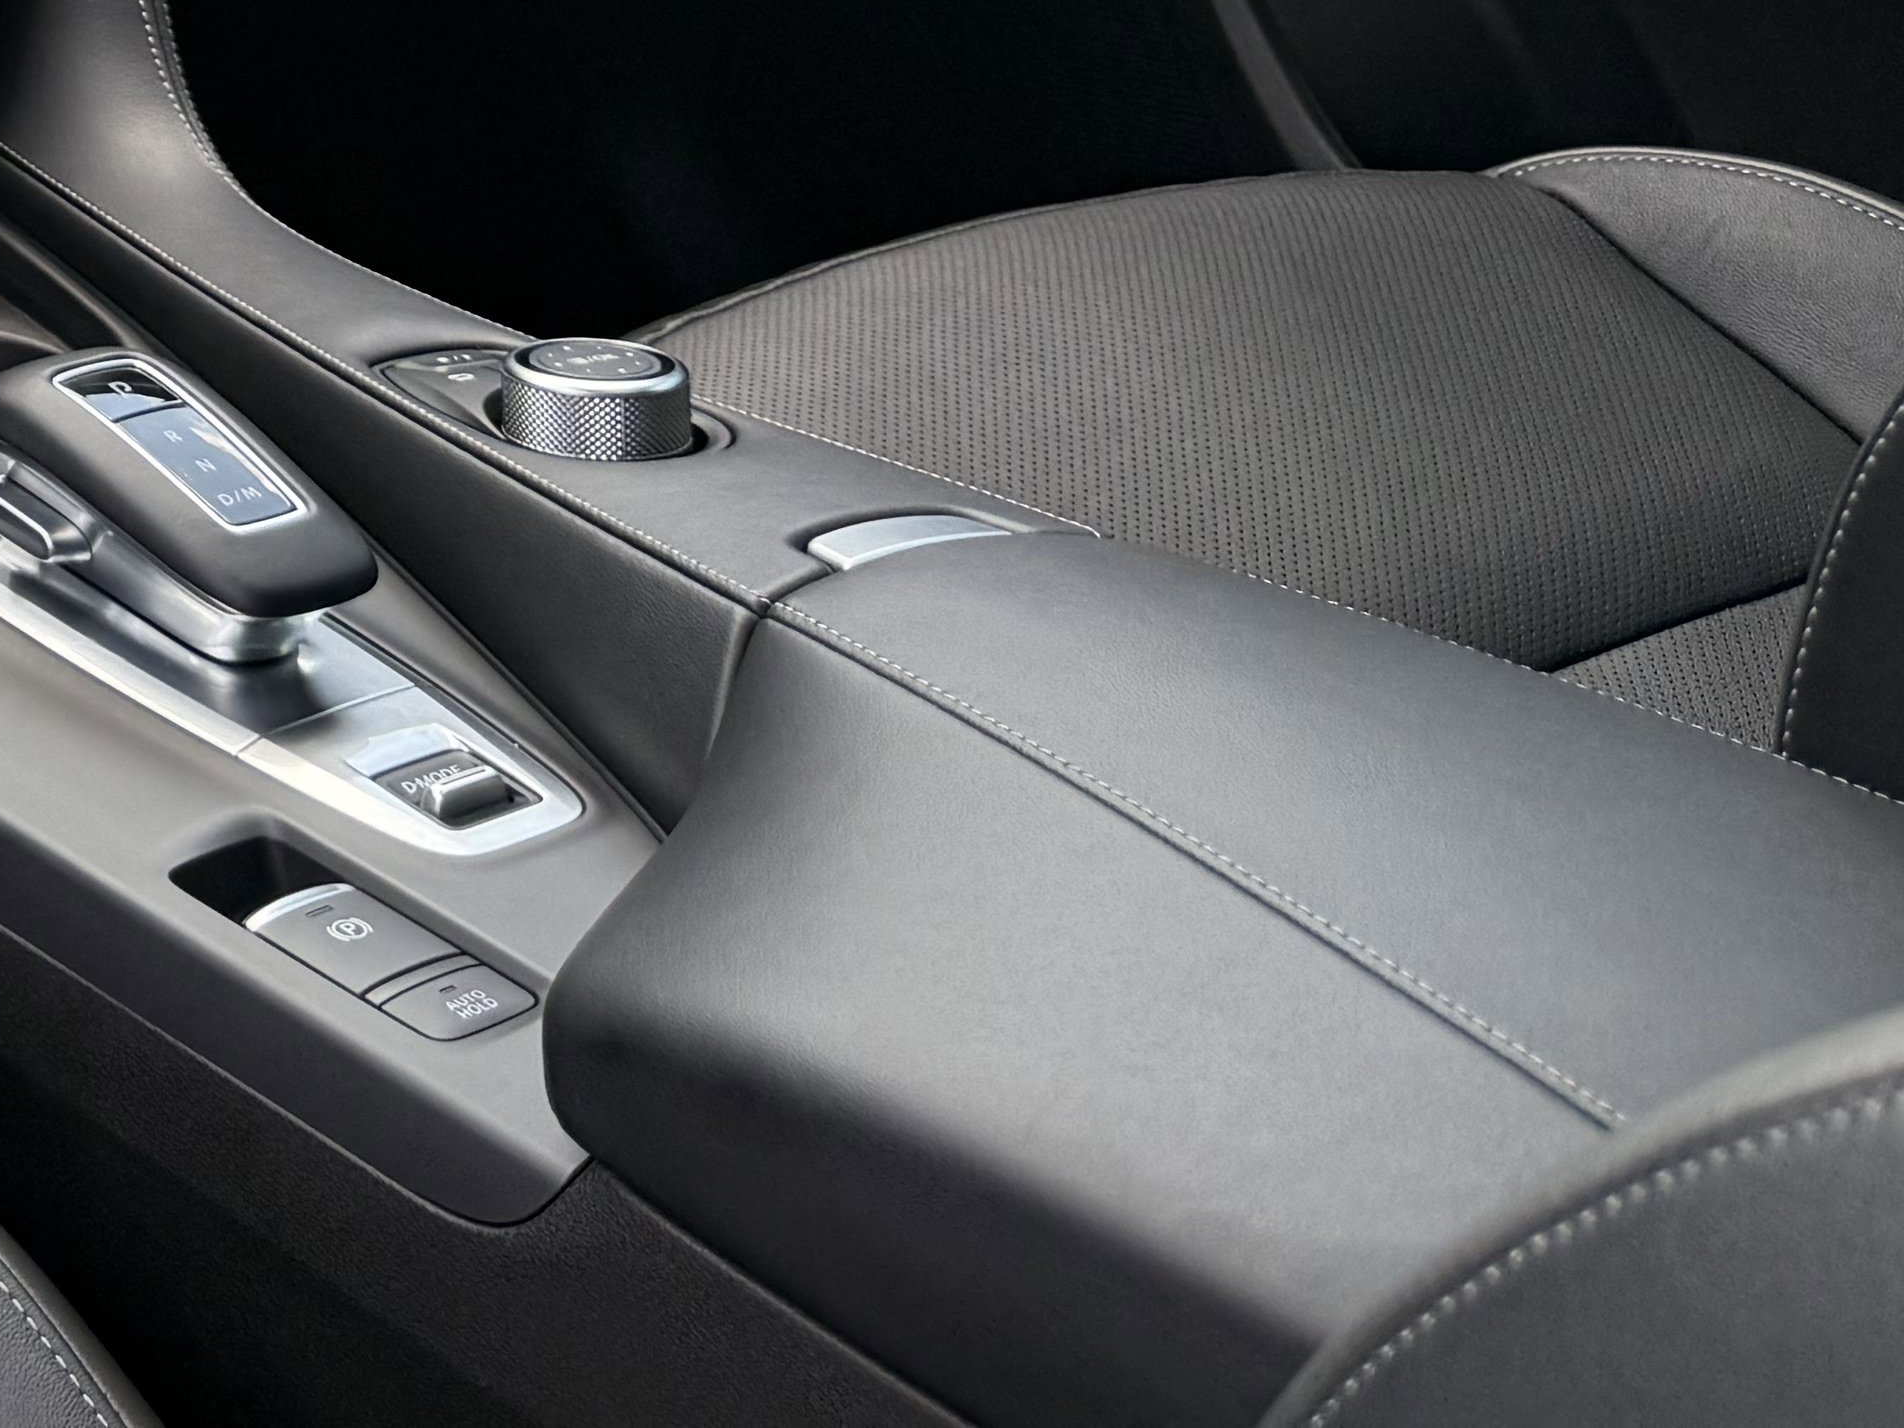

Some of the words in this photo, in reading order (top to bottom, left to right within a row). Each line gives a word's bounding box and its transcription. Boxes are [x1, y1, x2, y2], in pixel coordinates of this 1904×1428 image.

[162, 430, 183, 443] R
[194, 457, 217, 473] N
[217, 486, 262, 506] D/M
[445, 989, 486, 1011] AUTO
[455, 997, 498, 1020] HOLD
